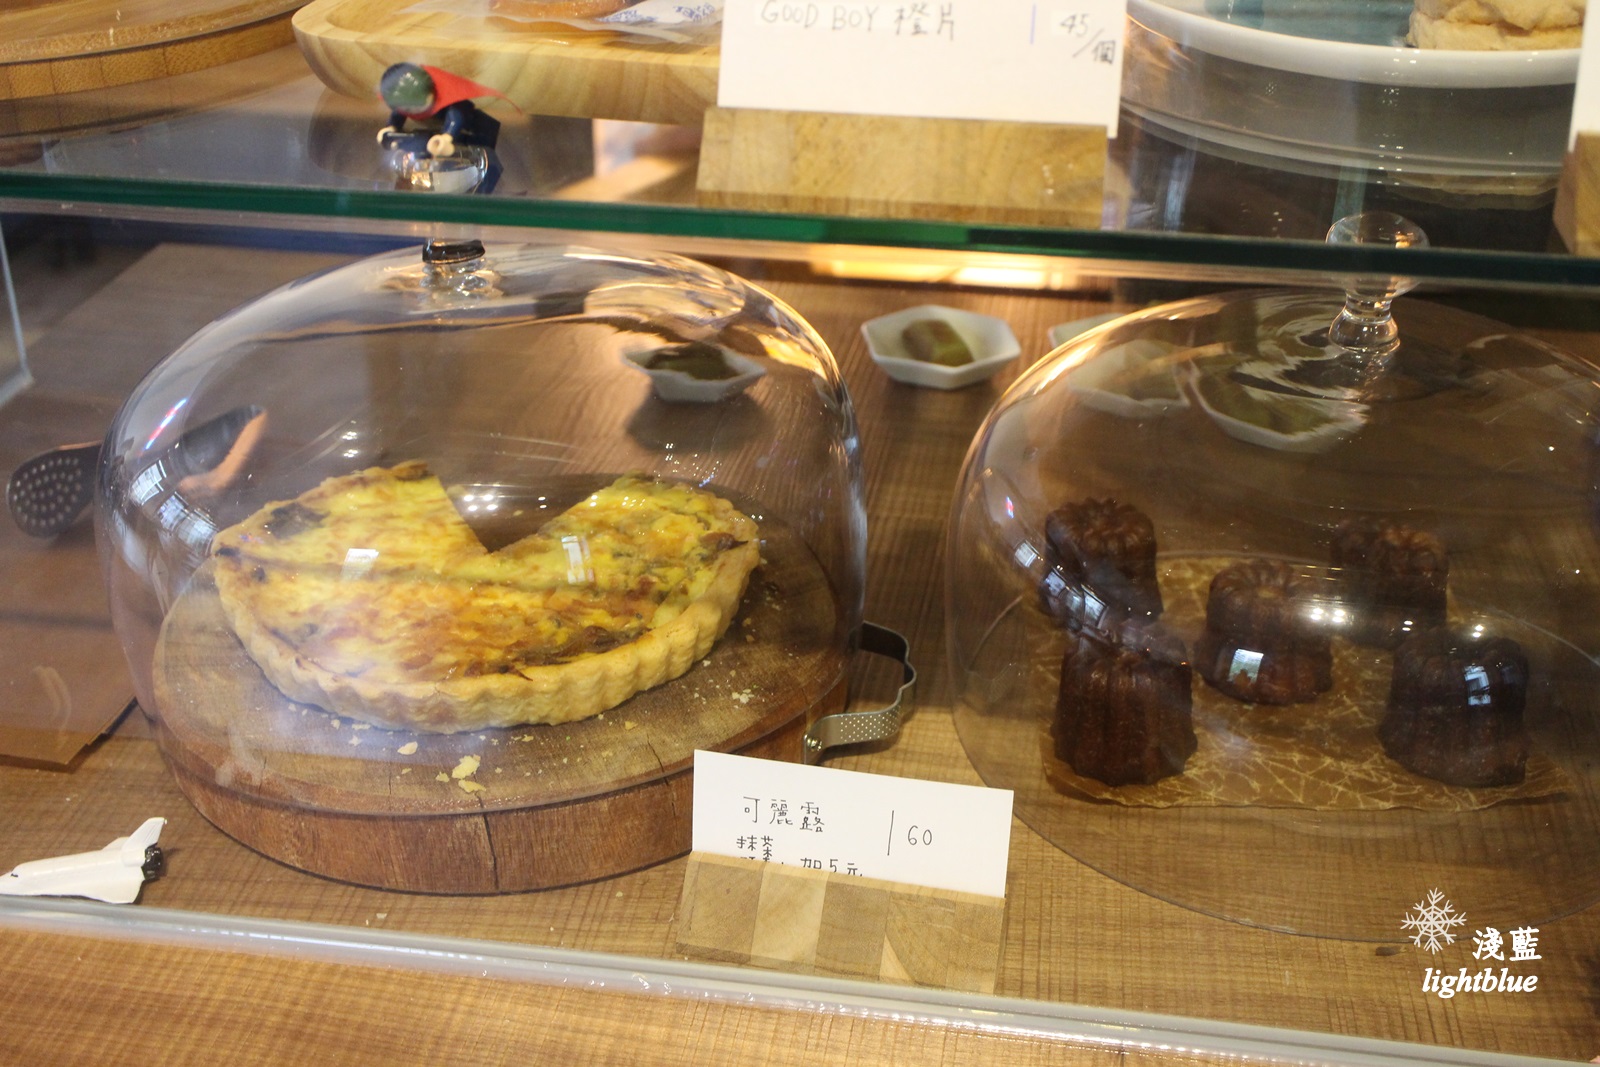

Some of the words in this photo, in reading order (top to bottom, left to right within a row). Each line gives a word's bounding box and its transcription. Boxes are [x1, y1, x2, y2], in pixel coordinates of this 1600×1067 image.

[761, 0, 819, 28] GOOD
[832, 4, 879, 32] BOY
[894, 2, 956, 41] 橙片
[743, 796, 825, 833] 可麗露
[736, 835, 773, 857] 抹茶
[907, 825, 933, 846] 60
